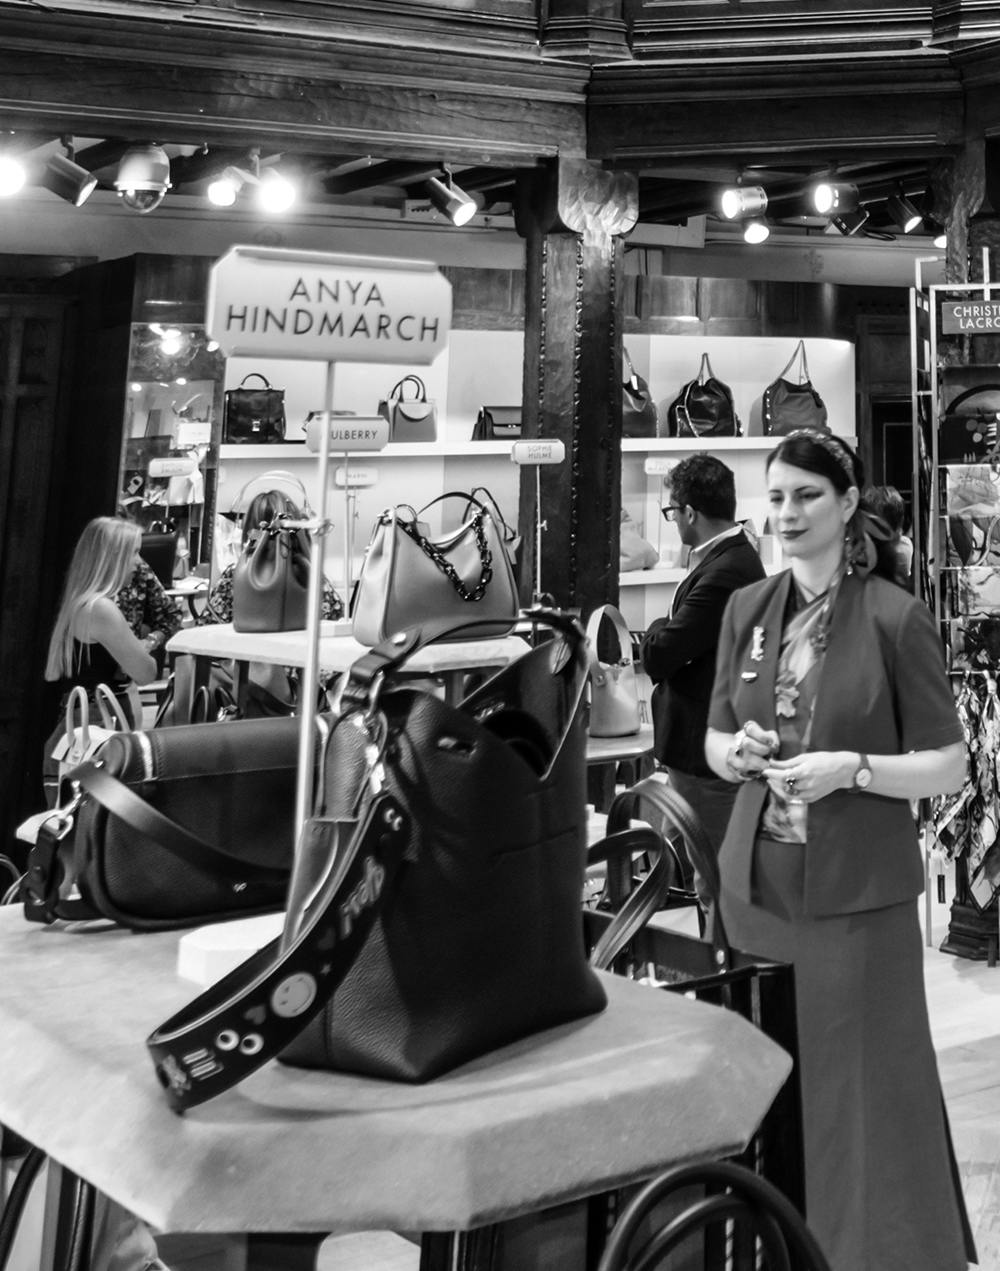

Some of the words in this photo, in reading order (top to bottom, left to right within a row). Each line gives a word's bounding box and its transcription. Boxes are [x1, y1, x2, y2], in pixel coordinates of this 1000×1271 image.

[289, 277, 385, 307] ANYA
[226, 304, 439, 342] HINDMARCH
[331, 430, 378, 440] ULBERRY
